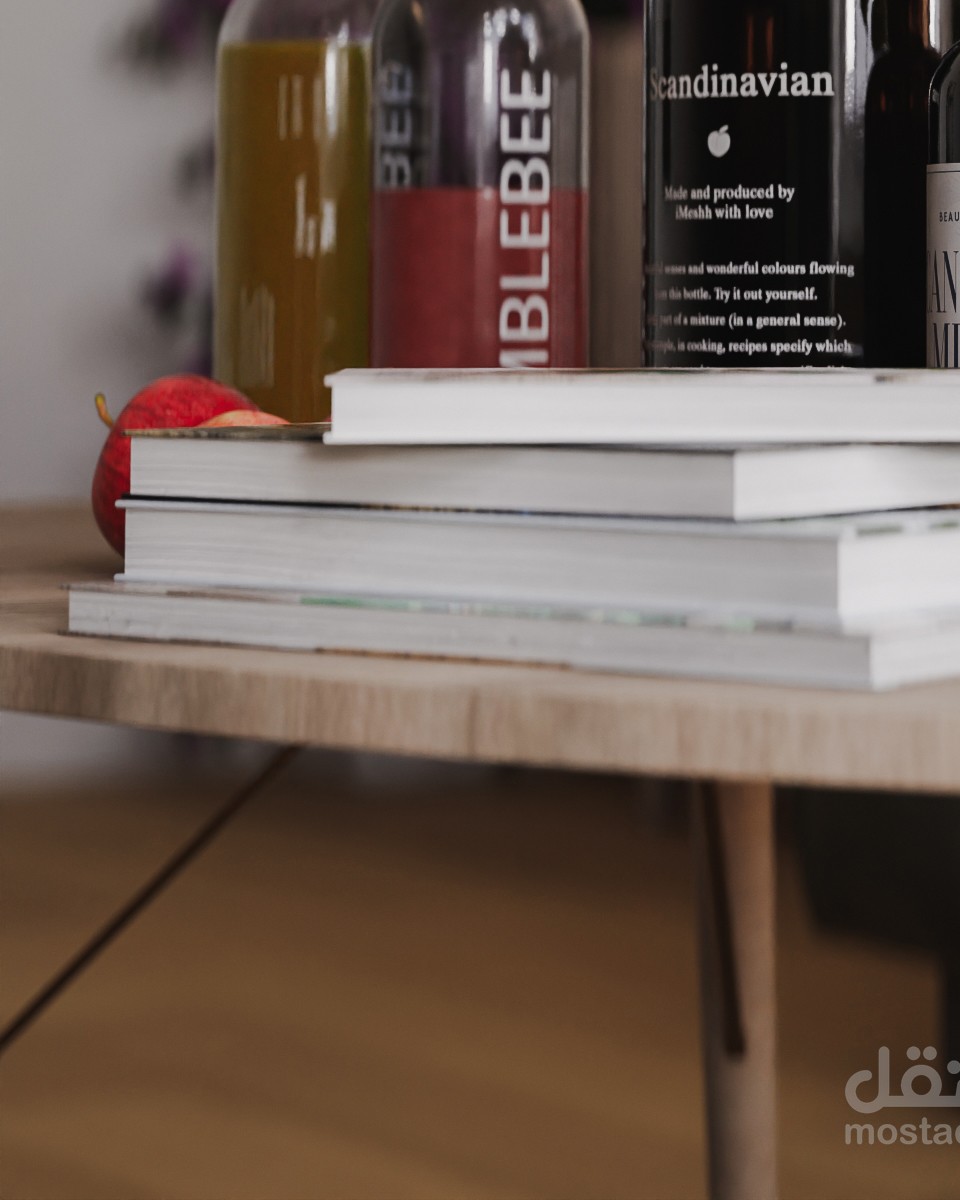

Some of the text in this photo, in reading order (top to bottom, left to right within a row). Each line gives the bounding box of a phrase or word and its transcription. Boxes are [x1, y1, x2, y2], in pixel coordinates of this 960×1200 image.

[650, 62, 835, 99] Scandinavian
[664, 183, 795, 203] Made and produced by
[715, 204, 741, 220] with
[745, 204, 774, 220] love
[688, 261, 704, 275] and
[706, 261, 759, 275] wonderful
[761, 261, 806, 275] colours
[809, 261, 855, 277] flowing
[683, 286, 711, 300] bottle.
[714, 286, 731, 304] Try
[733, 286, 741, 300] it
[743, 288, 763, 301] out
[765, 286, 818, 304] yourself.
[690, 312, 726, 326] mixture
[728, 312, 744, 330] (in
[746, 316, 753, 326] a
[756, 312, 800, 330] general
[803, 313, 846, 331] sense).
[677, 338, 685, 352] in
[686, 338, 726, 355] cooking,
[728, 338, 768, 356] recipes
[770, 338, 813, 356] specify
[815, 338, 853, 353] which
